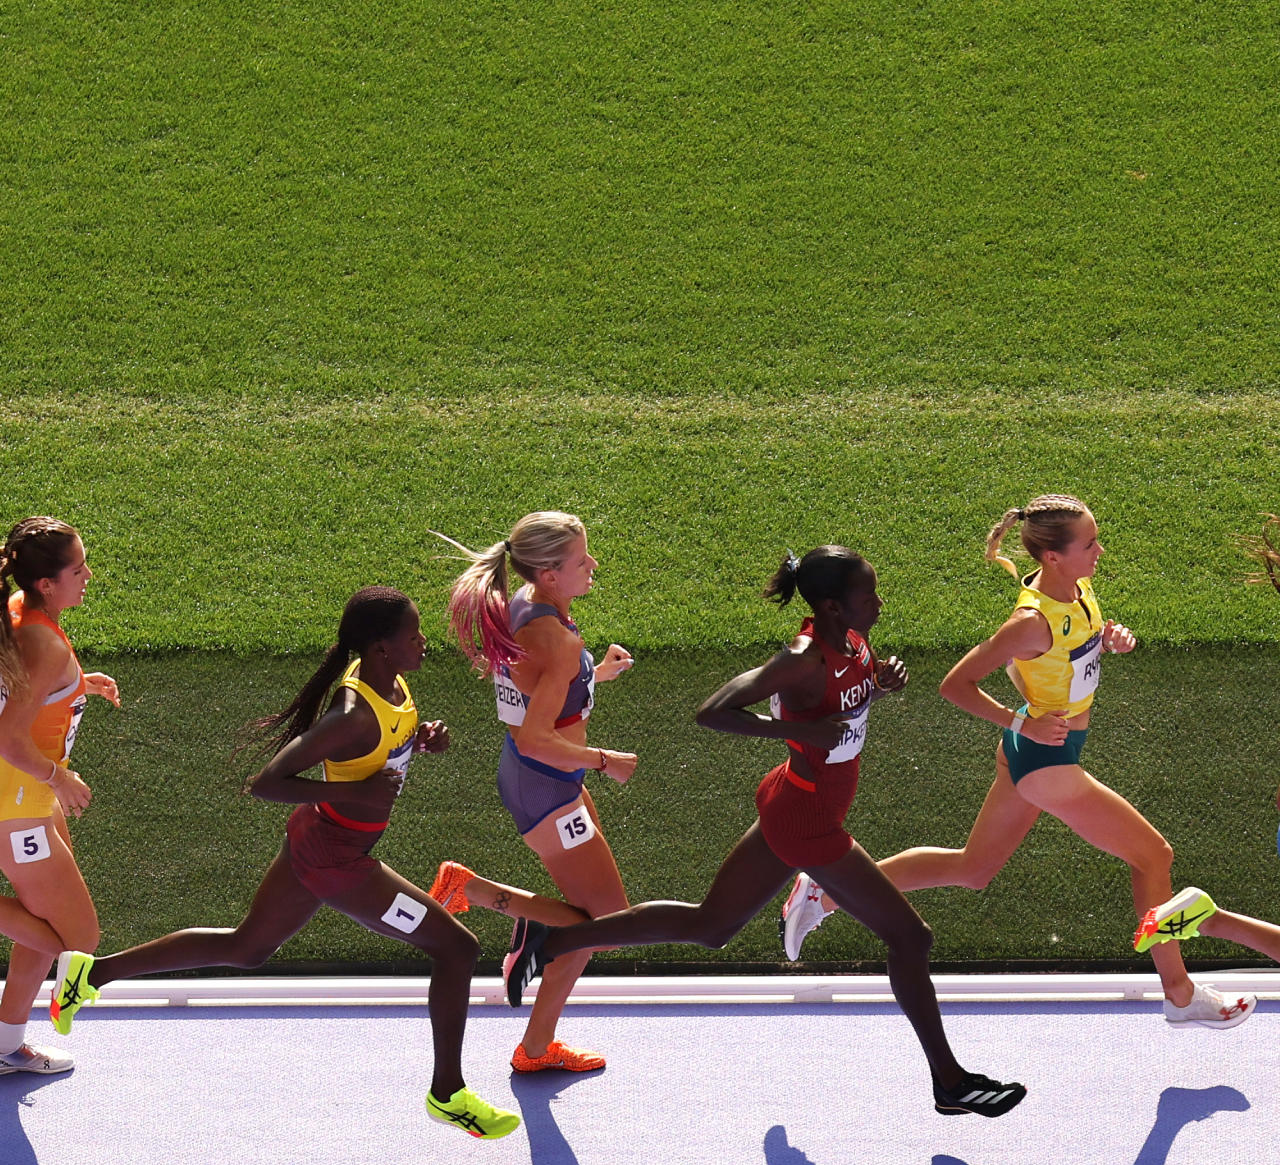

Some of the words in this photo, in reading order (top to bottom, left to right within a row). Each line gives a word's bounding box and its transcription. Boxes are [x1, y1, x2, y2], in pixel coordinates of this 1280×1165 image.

[840, 678, 875, 711] KENY
[564, 816, 587, 839] 15
[23, 835, 39, 856] 5
[396, 908, 416, 922] 1
